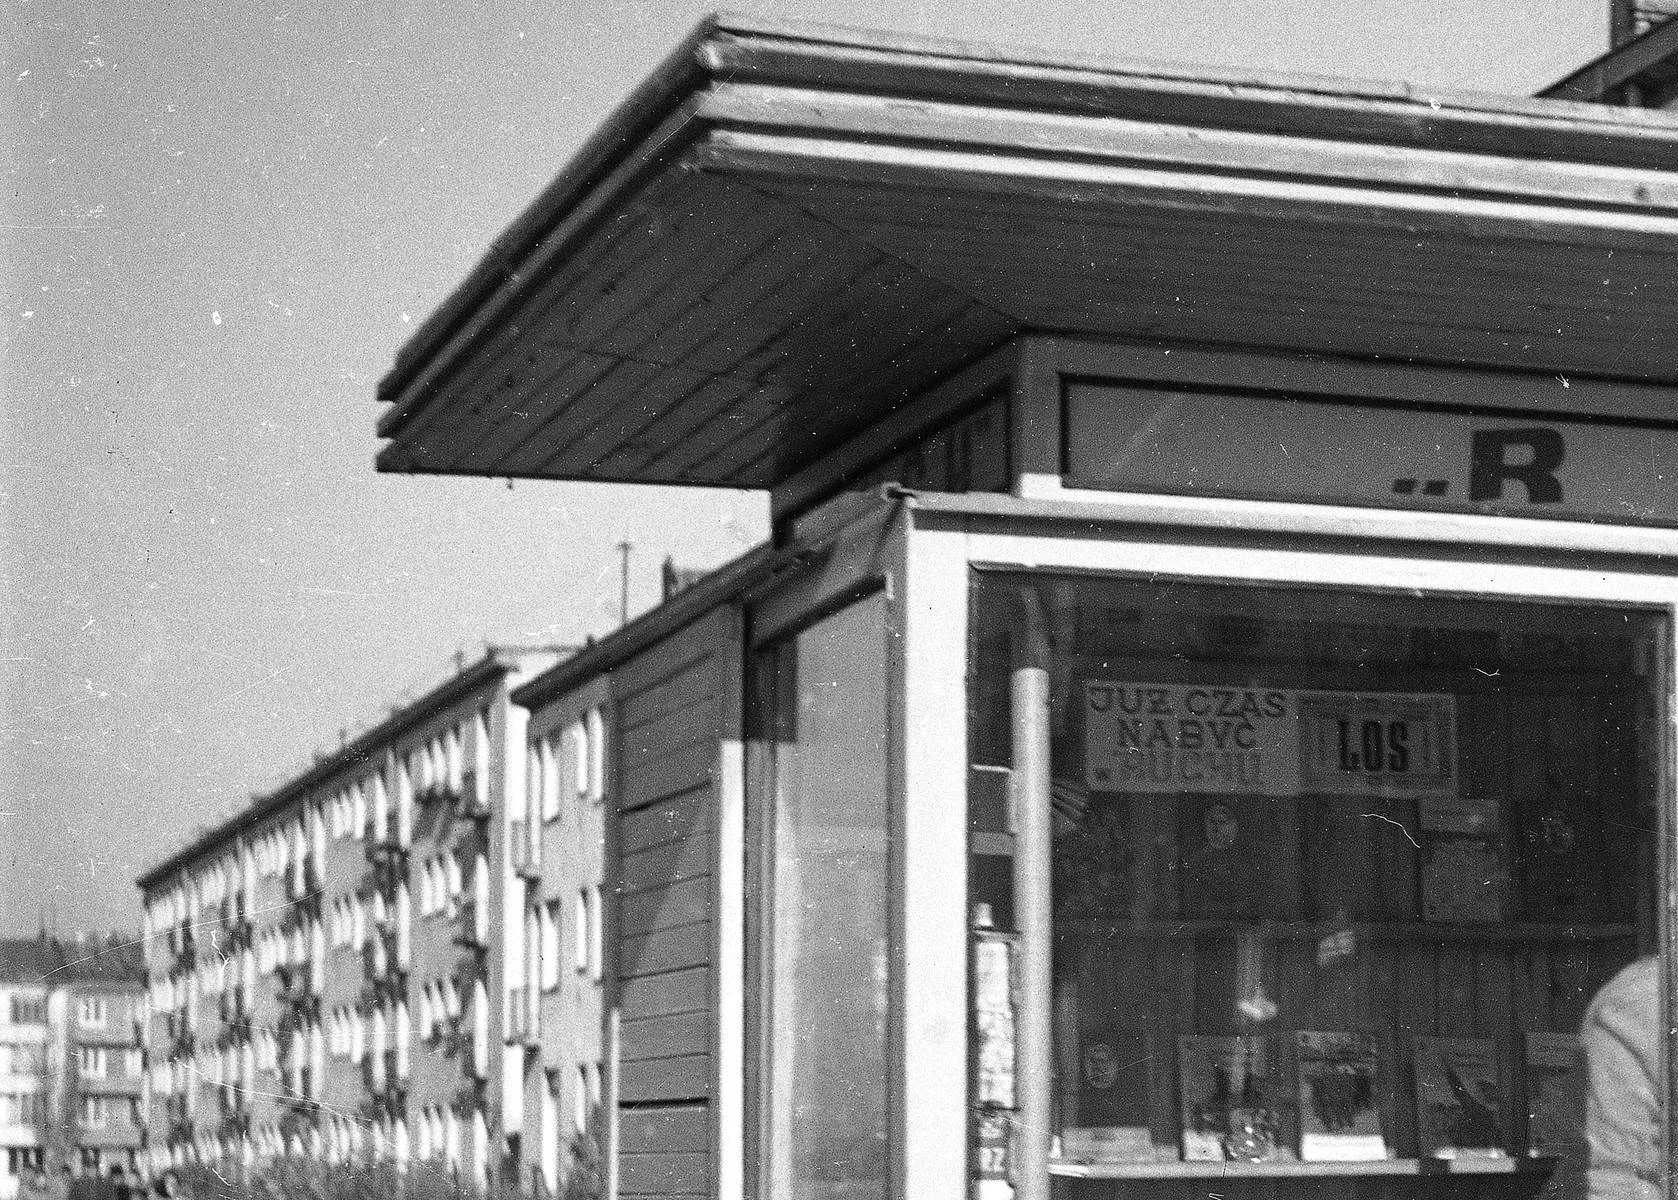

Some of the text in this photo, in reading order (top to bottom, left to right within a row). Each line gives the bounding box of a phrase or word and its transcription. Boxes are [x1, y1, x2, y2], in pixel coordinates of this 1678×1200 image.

[1185, 689, 1287, 718] CZAS
[1116, 714, 1257, 750] NABYĆ
[1336, 719, 1409, 772] LOS
